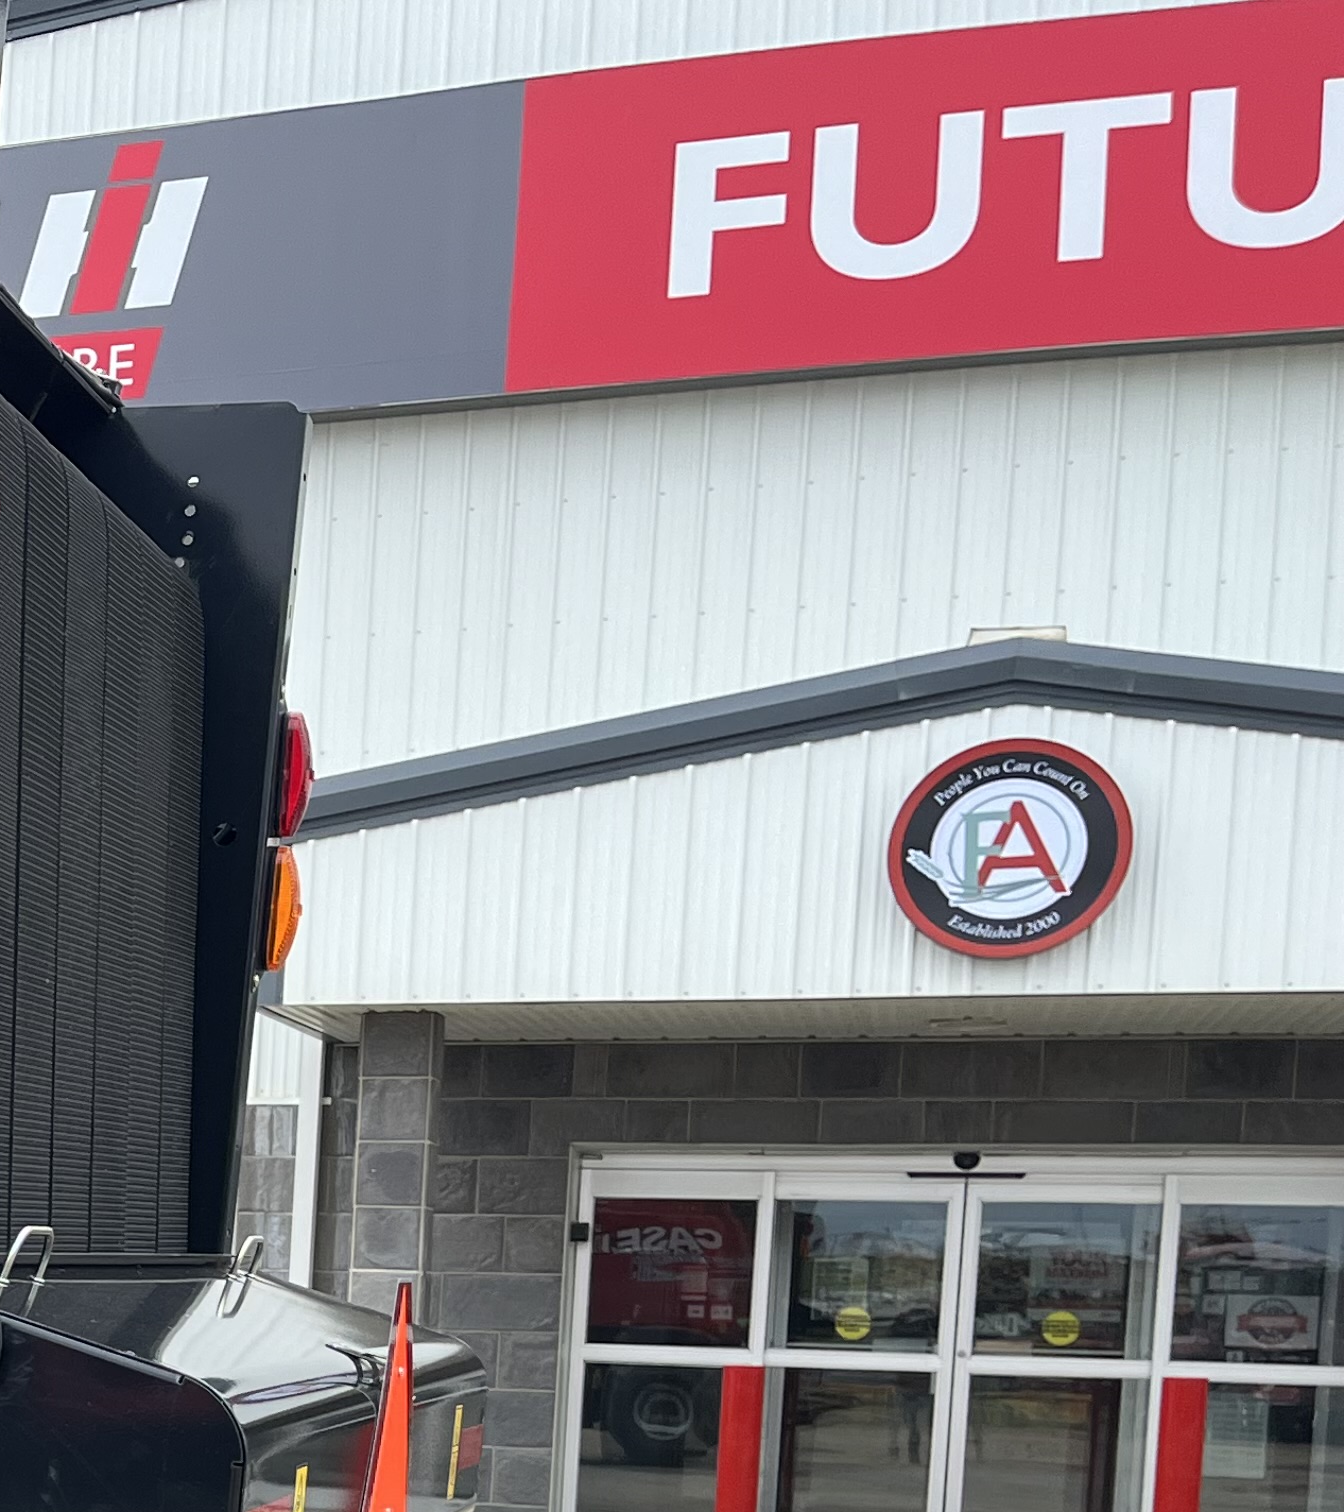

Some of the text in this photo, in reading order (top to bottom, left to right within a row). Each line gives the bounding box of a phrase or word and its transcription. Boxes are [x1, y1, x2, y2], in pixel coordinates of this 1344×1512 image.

[666, 78, 1344, 300] FUTU
[932, 758, 1091, 807] People You Can Count On
[947, 911, 1062, 939] Established 2000
